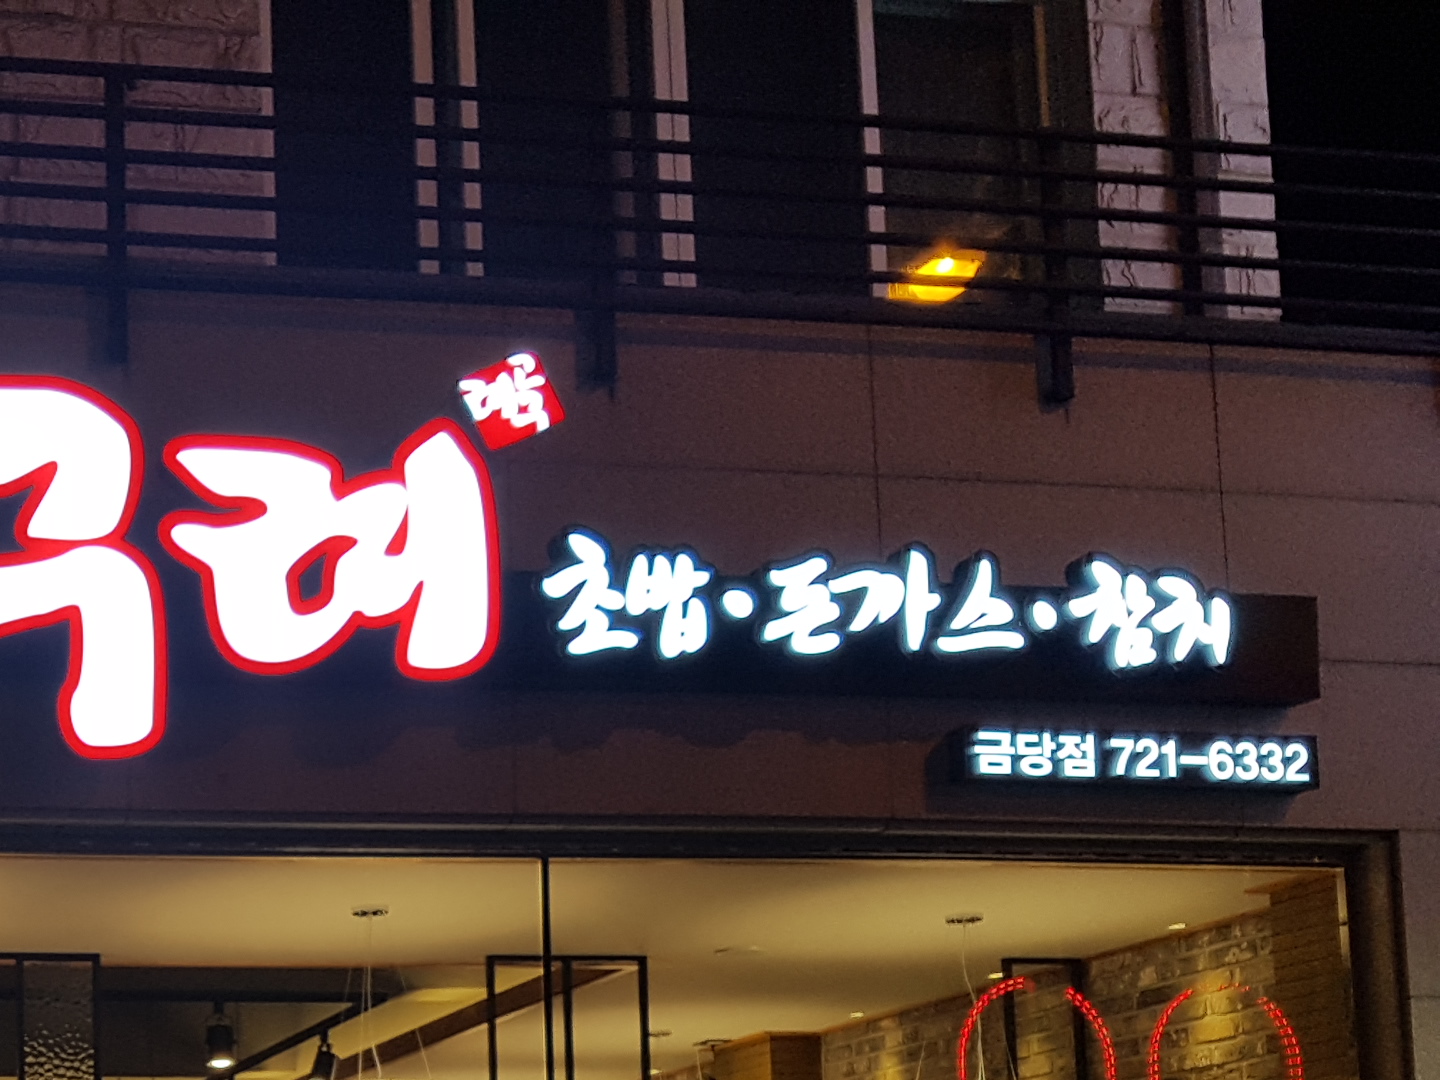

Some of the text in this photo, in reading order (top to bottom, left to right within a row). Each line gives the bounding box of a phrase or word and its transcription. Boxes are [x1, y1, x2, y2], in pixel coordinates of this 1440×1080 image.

[541, 532, 1232, 669] 초밥 돈까스 참치
[972, 730, 1311, 783] 금당점 721-6332
